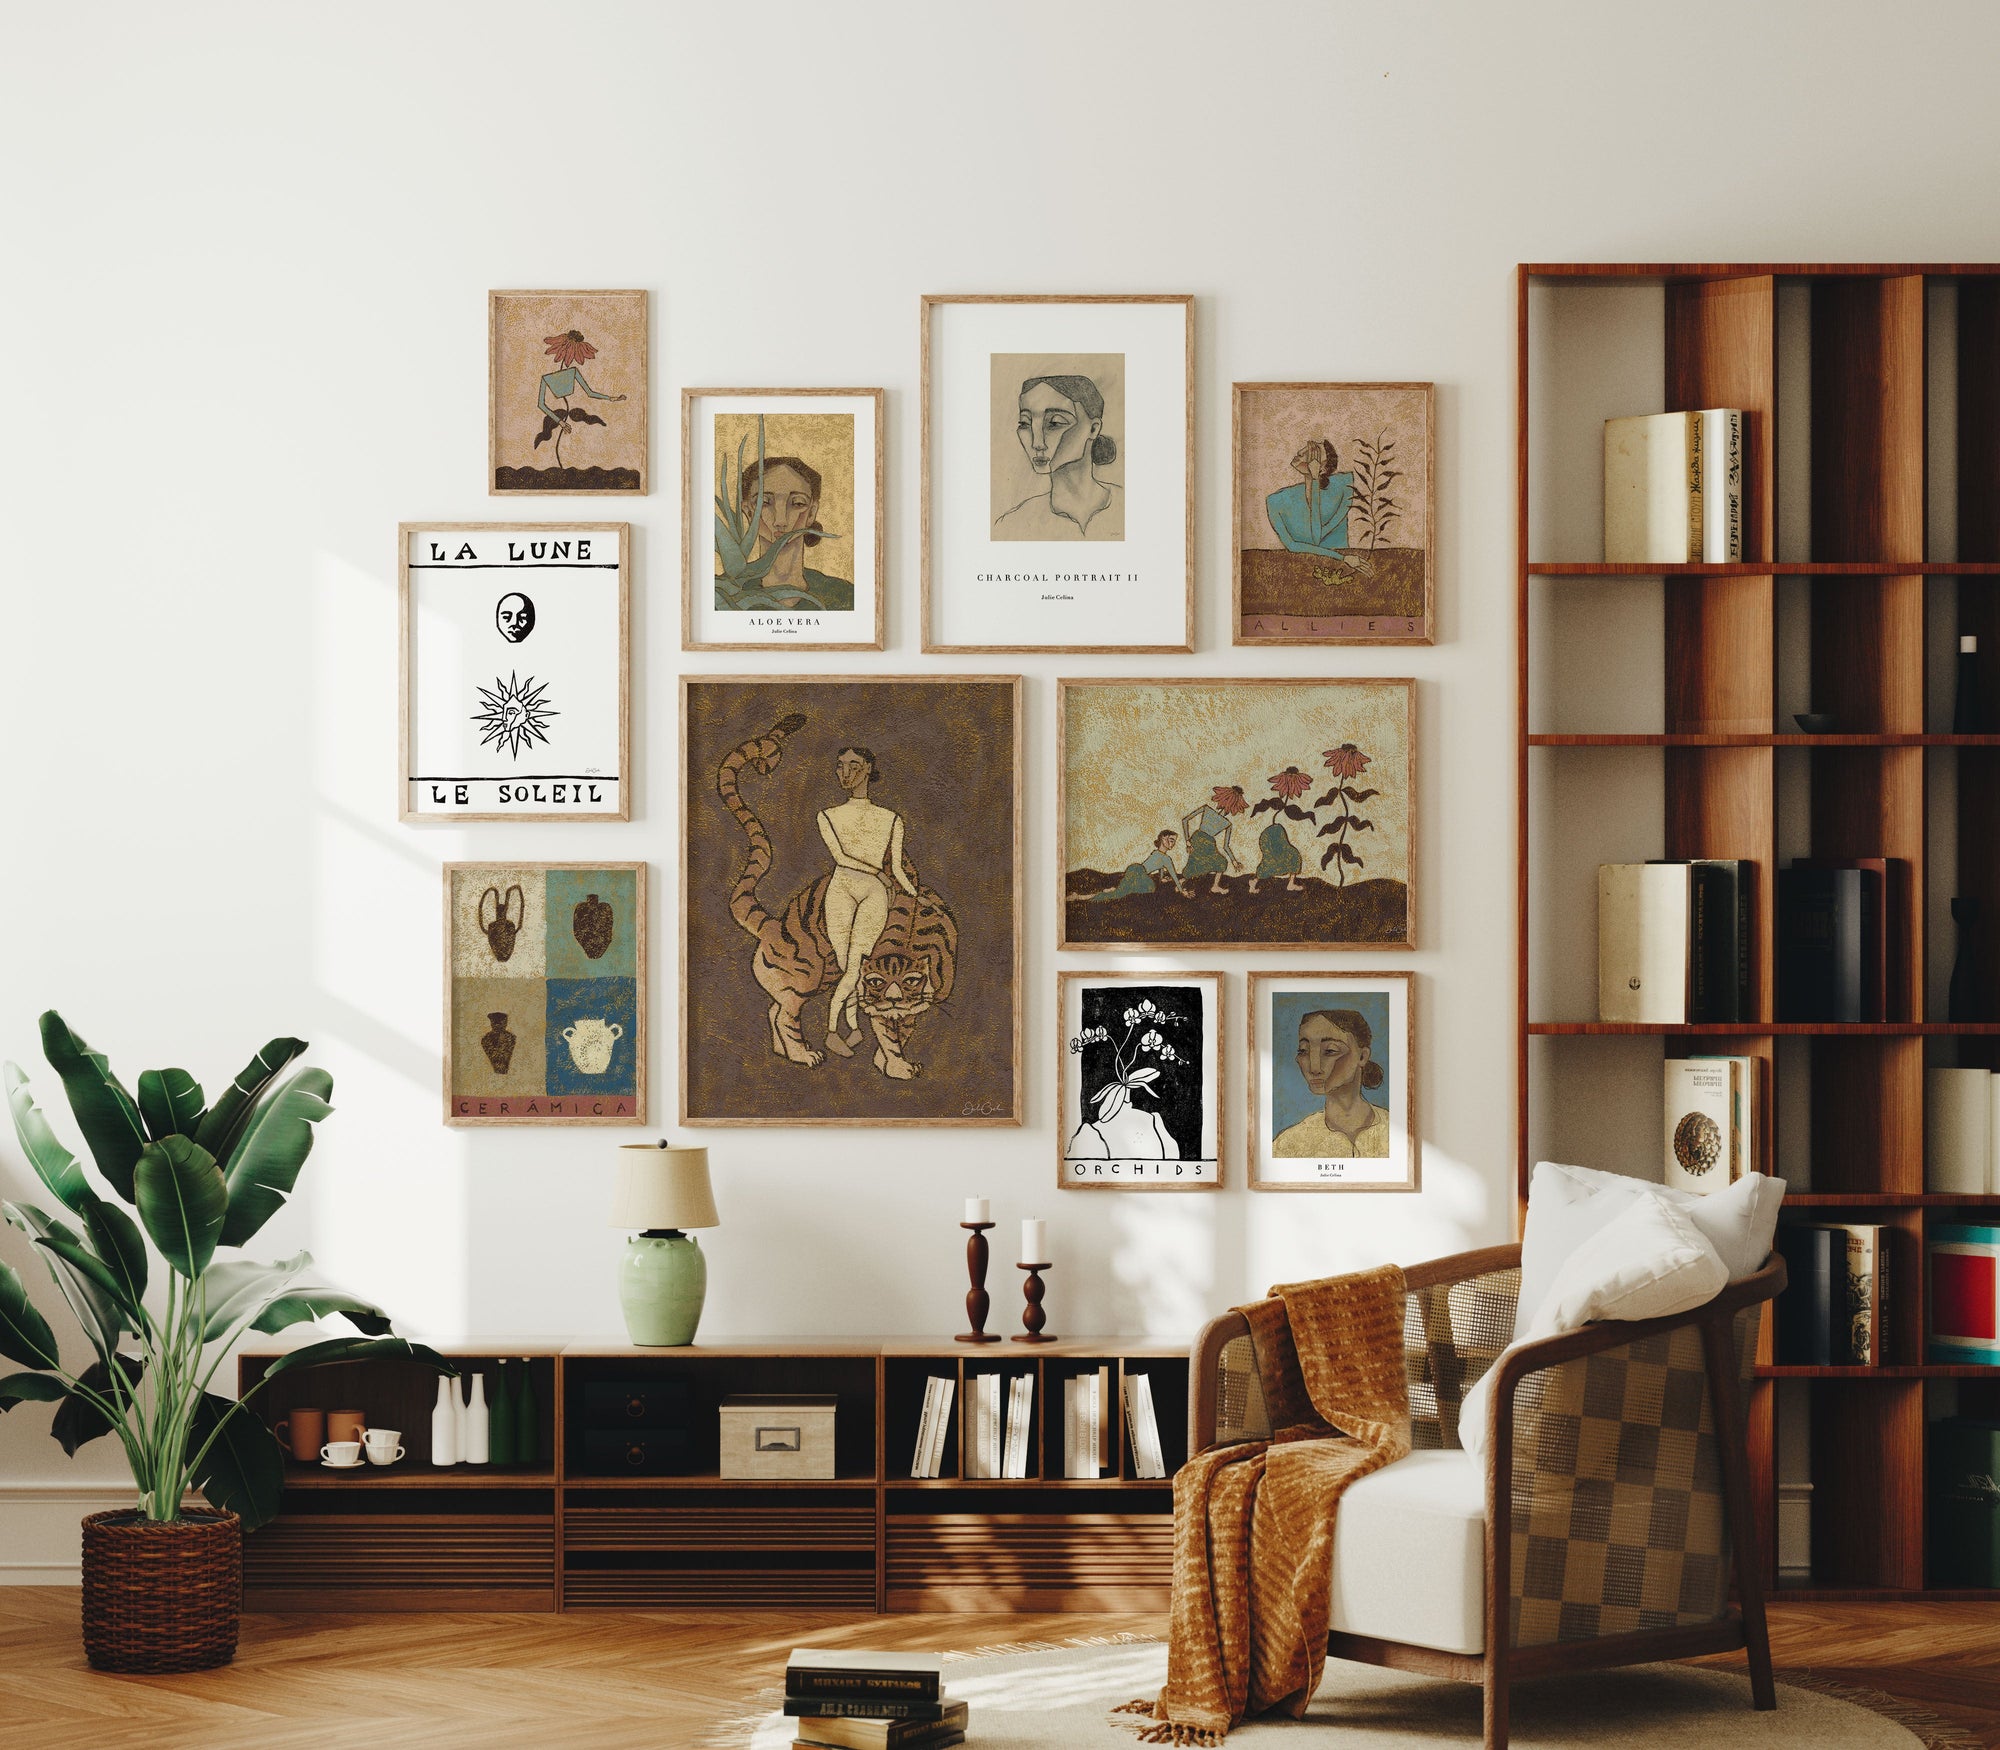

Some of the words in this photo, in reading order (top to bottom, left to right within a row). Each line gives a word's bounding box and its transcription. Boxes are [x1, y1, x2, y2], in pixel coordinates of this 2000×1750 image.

[1692, 418, 1702, 454] жизни
[1690, 456, 1702, 494] Жажда
[430, 542, 478, 561] LA
[508, 540, 591, 561] LUNE
[977, 574, 1048, 582] CHARCOAL
[1055, 574, 1121, 582] PORTRAIT
[1127, 574, 1138, 582] II
[1254, 620, 1415, 632] ALLIES
[432, 784, 470, 805] LE
[499, 783, 602, 804] SOLEIL
[460, 1100, 626, 1115] CERÁMICA
[1074, 1163, 1203, 1176] ORCHIDS
